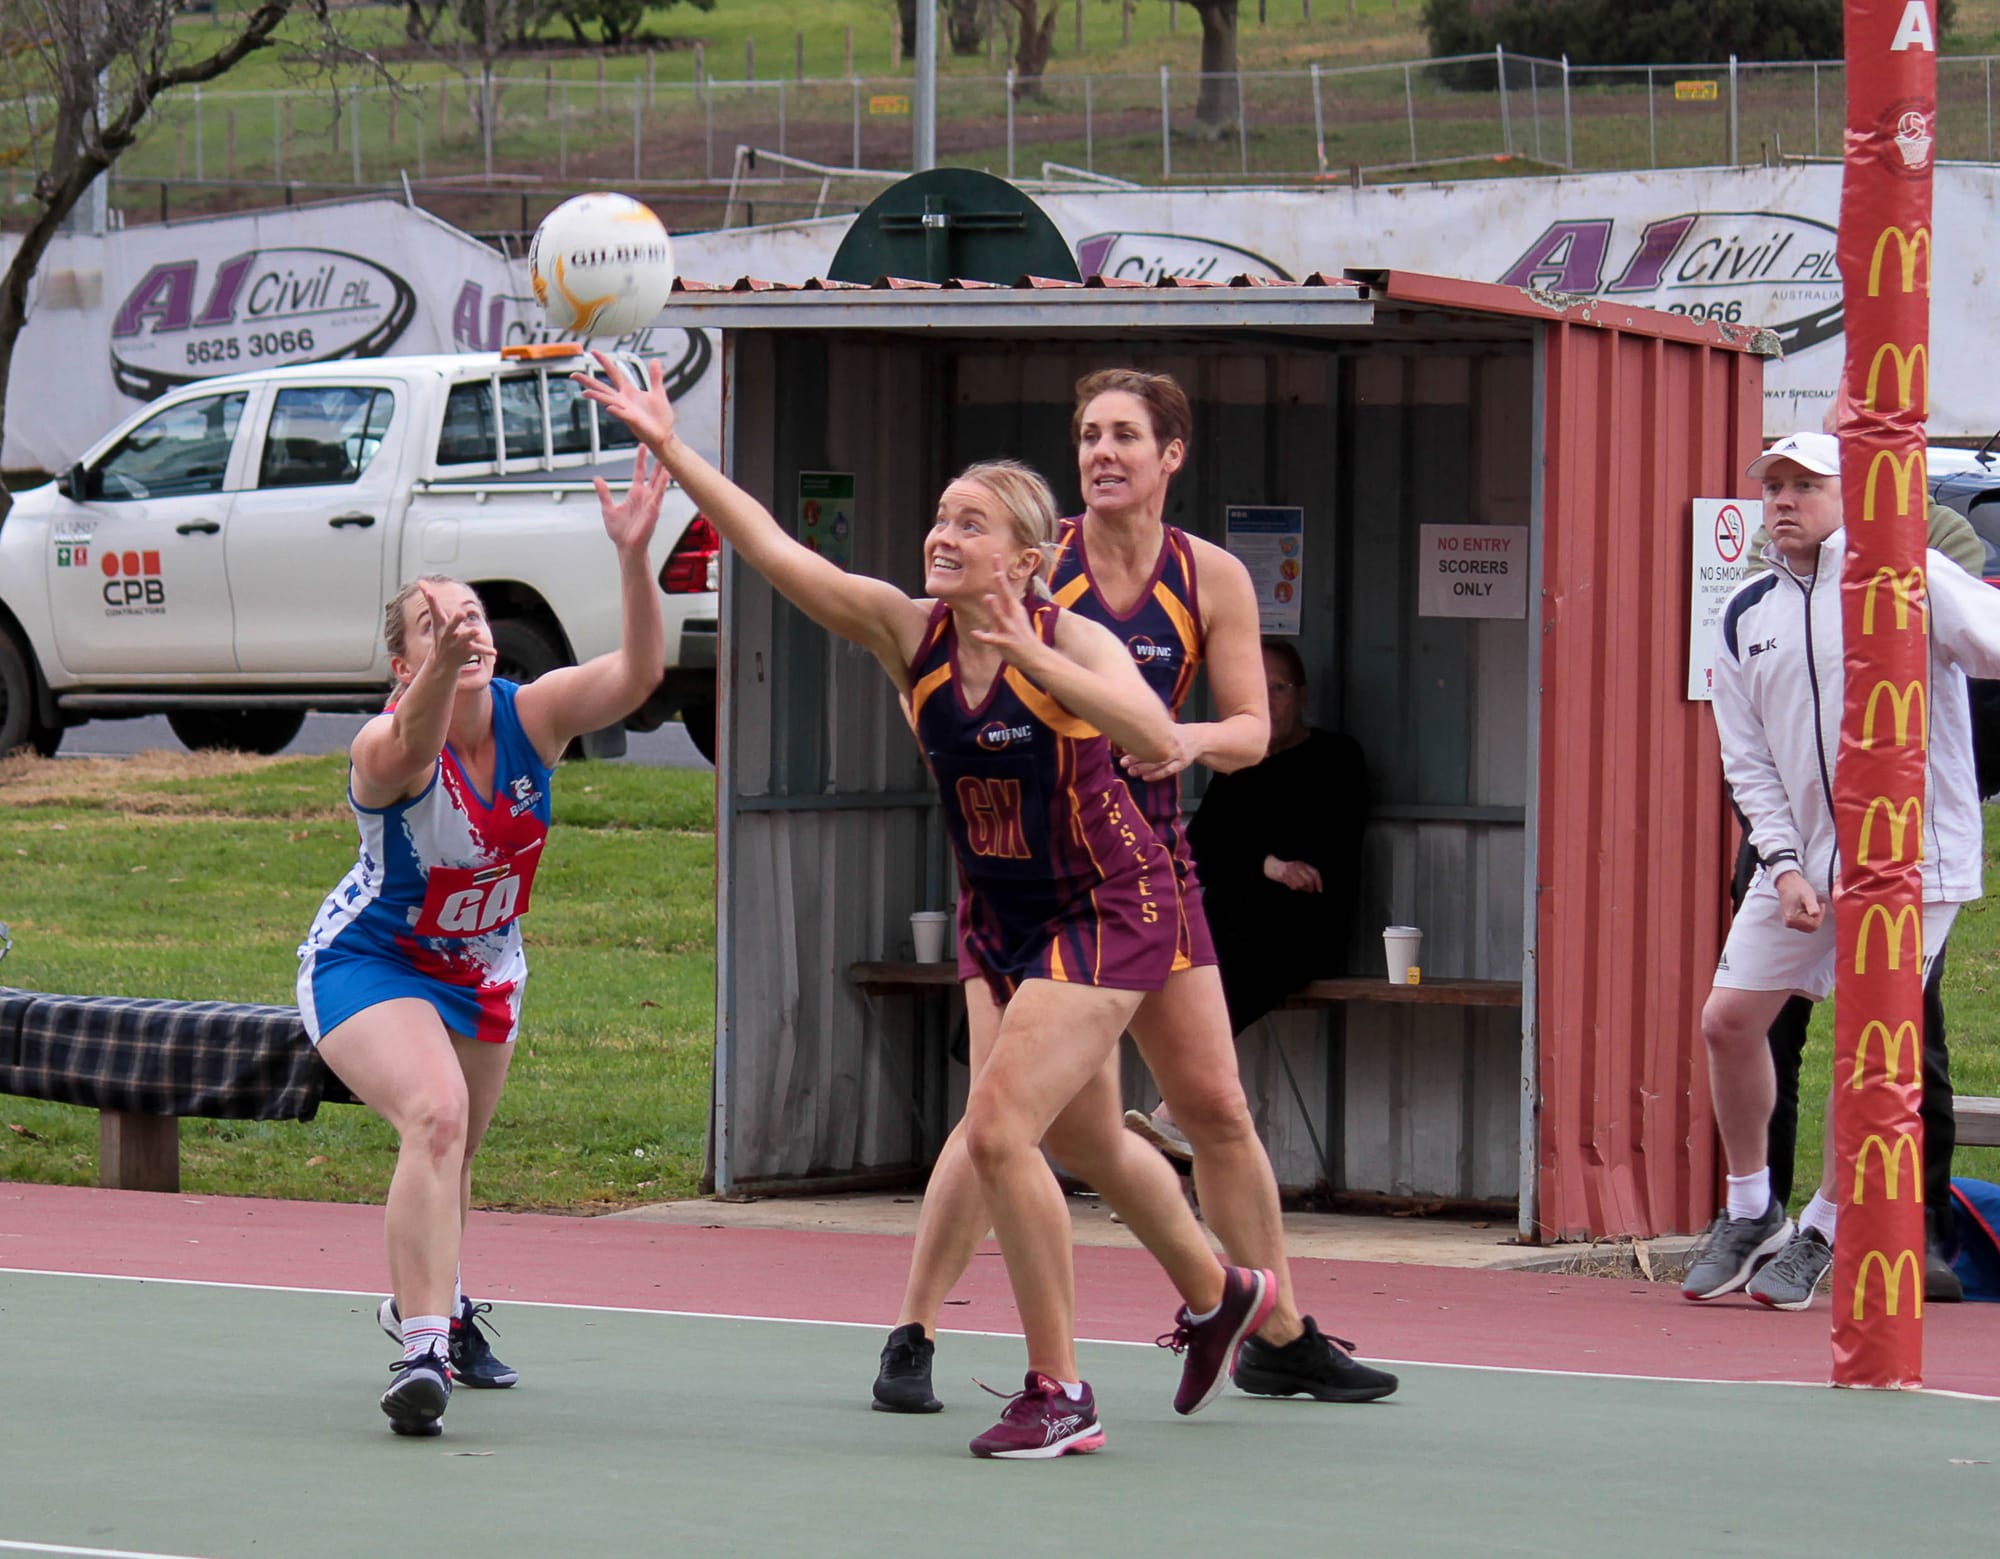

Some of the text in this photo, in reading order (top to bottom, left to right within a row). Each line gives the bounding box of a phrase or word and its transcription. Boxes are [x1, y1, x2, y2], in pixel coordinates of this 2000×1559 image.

[1676, 231, 1795, 284] Civil
[247, 264, 336, 316] Civil
[1770, 288, 1841, 301] AUSTRALIA
[185, 337, 241, 365] 5625
[248, 327, 315, 358] 3066
[1437, 536, 1512, 552] NO ENTRY
[1438, 559, 1509, 575] SCORERS
[1700, 566, 1713, 581] NO
[103, 579, 165, 606] CPB
[1453, 581, 1494, 597] ONLY
[1748, 637, 1778, 658] BLK
[509, 791, 543, 818] BUNYIP
[436, 873, 521, 932] GA
